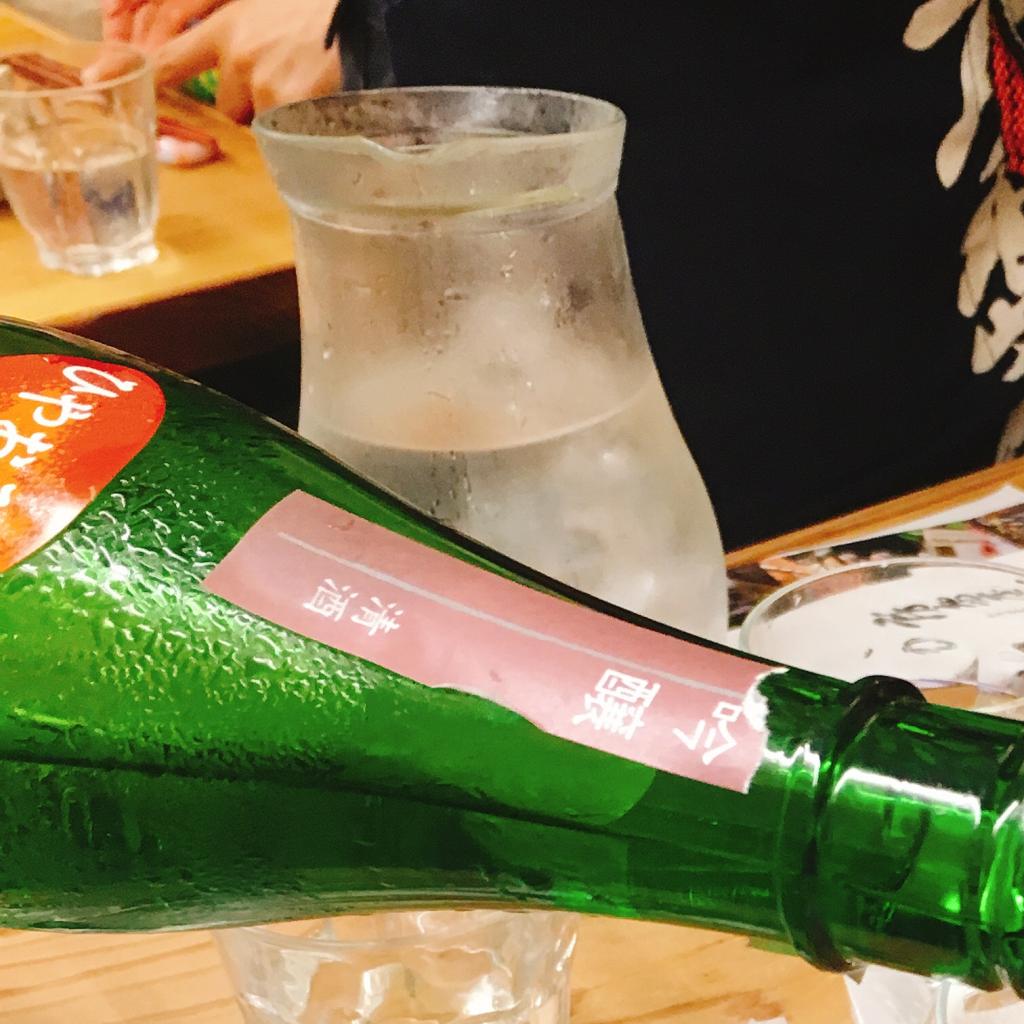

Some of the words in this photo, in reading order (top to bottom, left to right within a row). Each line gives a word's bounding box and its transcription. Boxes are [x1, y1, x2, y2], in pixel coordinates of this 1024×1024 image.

[0, 365, 138, 507] ひやお
[302, 578, 404, 636] 清酒
[571, 668, 743, 765] 吟醸
